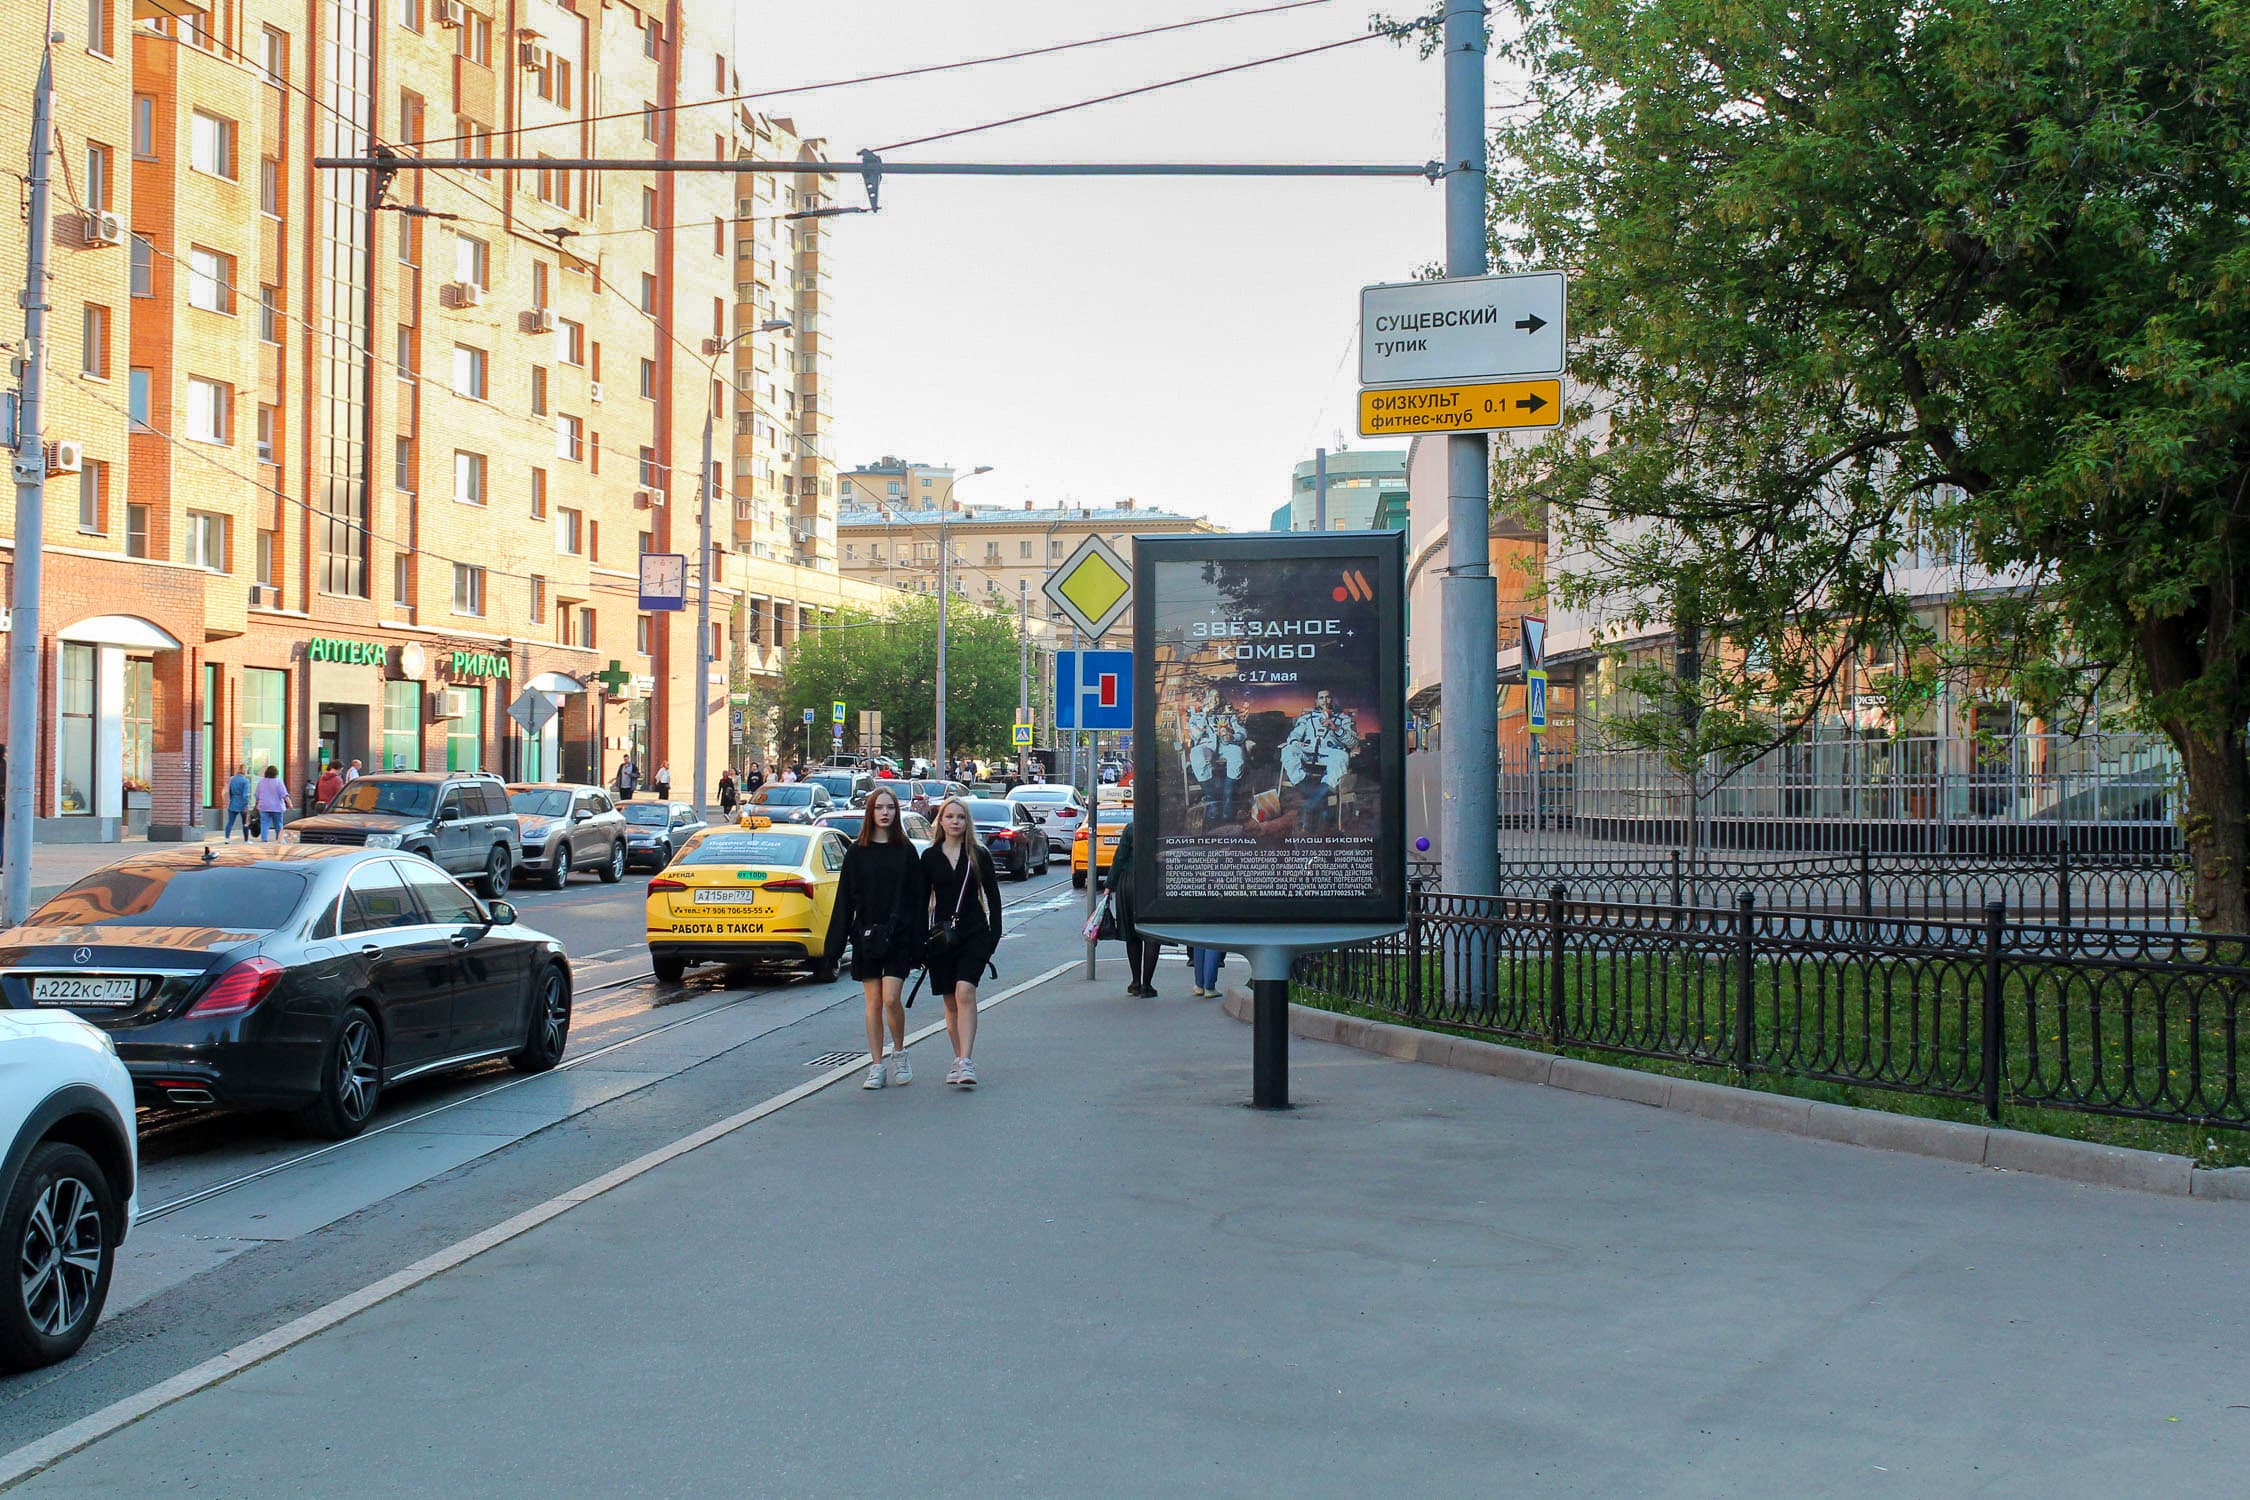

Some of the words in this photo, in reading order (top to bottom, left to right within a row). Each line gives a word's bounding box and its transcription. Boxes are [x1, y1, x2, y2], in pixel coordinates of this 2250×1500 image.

[1376, 305, 1497, 332] СУЩЕВСКИЙ
[1376, 339, 1427, 357] тупик
[1372, 393, 1459, 410] ФИЗКУЛЬТ
[1484, 399, 1506, 413] 0.1
[1371, 409, 1473, 429] фитнес-клуб
[1192, 617, 1341, 637] ЗВЁЗДНОЕ
[309, 637, 388, 666] АПТЕКА
[1217, 644, 1315, 660] КОМБО
[452, 652, 510, 678] РИГЛА
[1239, 673, 1246, 682] с
[1250, 671, 1266, 681] 17
[1270, 672, 1297, 681] мая
[672, 924, 713, 933] РАБОТА
[717, 924, 723, 933] В
[729, 924, 764, 933] ТАКСИ
[39, 981, 103, 997] А222КС
[106, 980, 130, 993] 777
